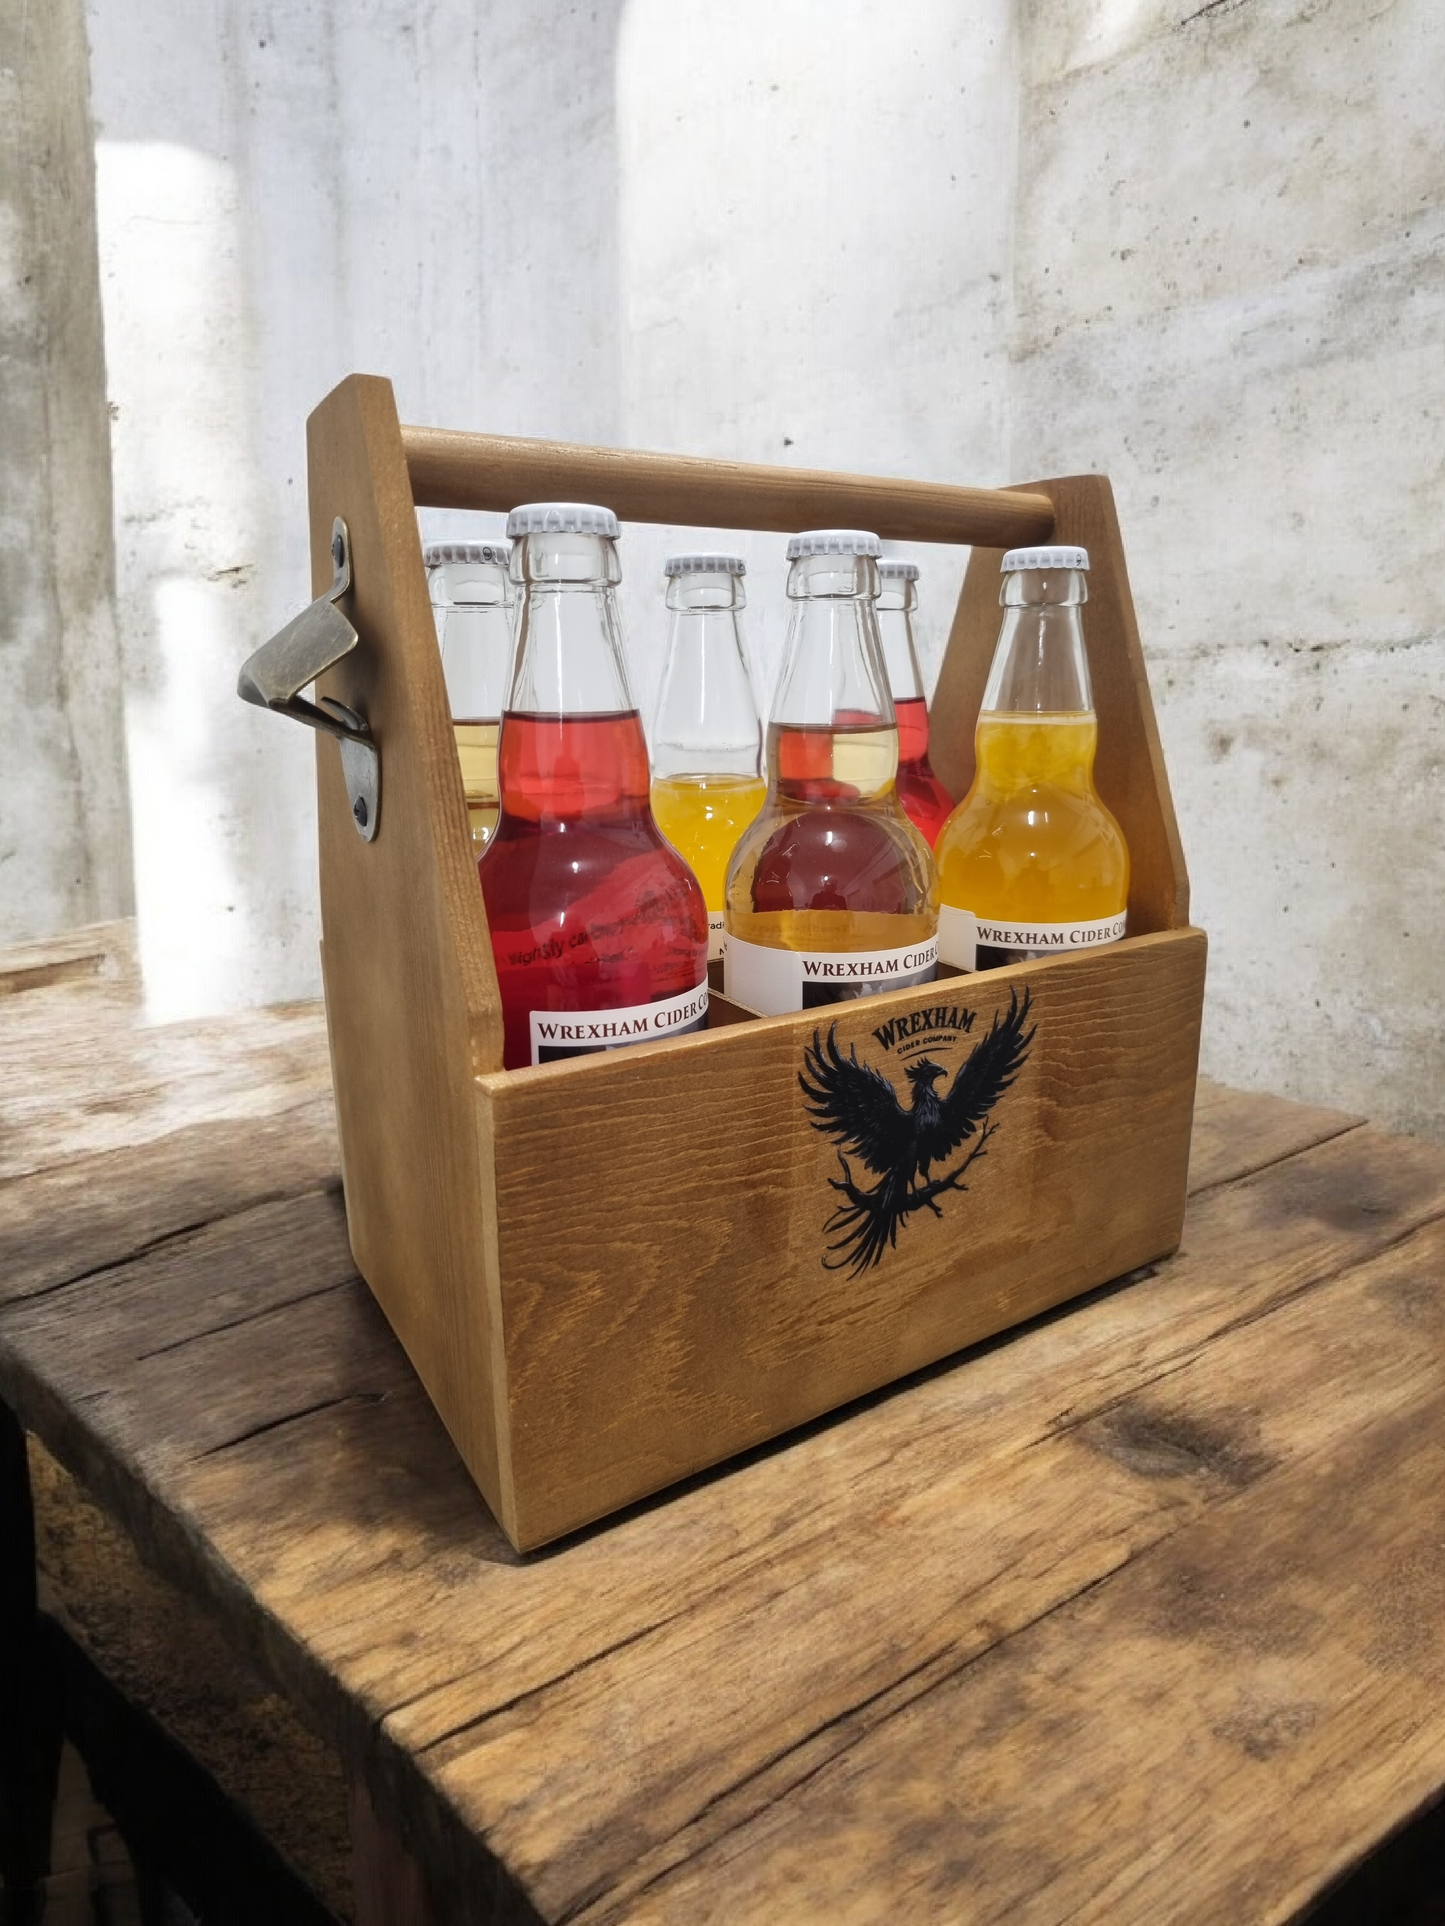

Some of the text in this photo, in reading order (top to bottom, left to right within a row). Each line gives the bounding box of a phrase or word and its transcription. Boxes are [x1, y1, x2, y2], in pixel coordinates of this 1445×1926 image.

[976, 926, 1065, 945] WREXHAM
[1069, 927, 1110, 944] CIDER
[802, 958, 899, 977] WREXHAM
[903, 947, 935, 969] CIDER
[537, 1017, 648, 1040] WREXHAM
[654, 1002, 697, 1028] CIDER
[872, 1006, 978, 1051] WREXHAM
[897, 1035, 957, 1054] CIDER COMPANY
